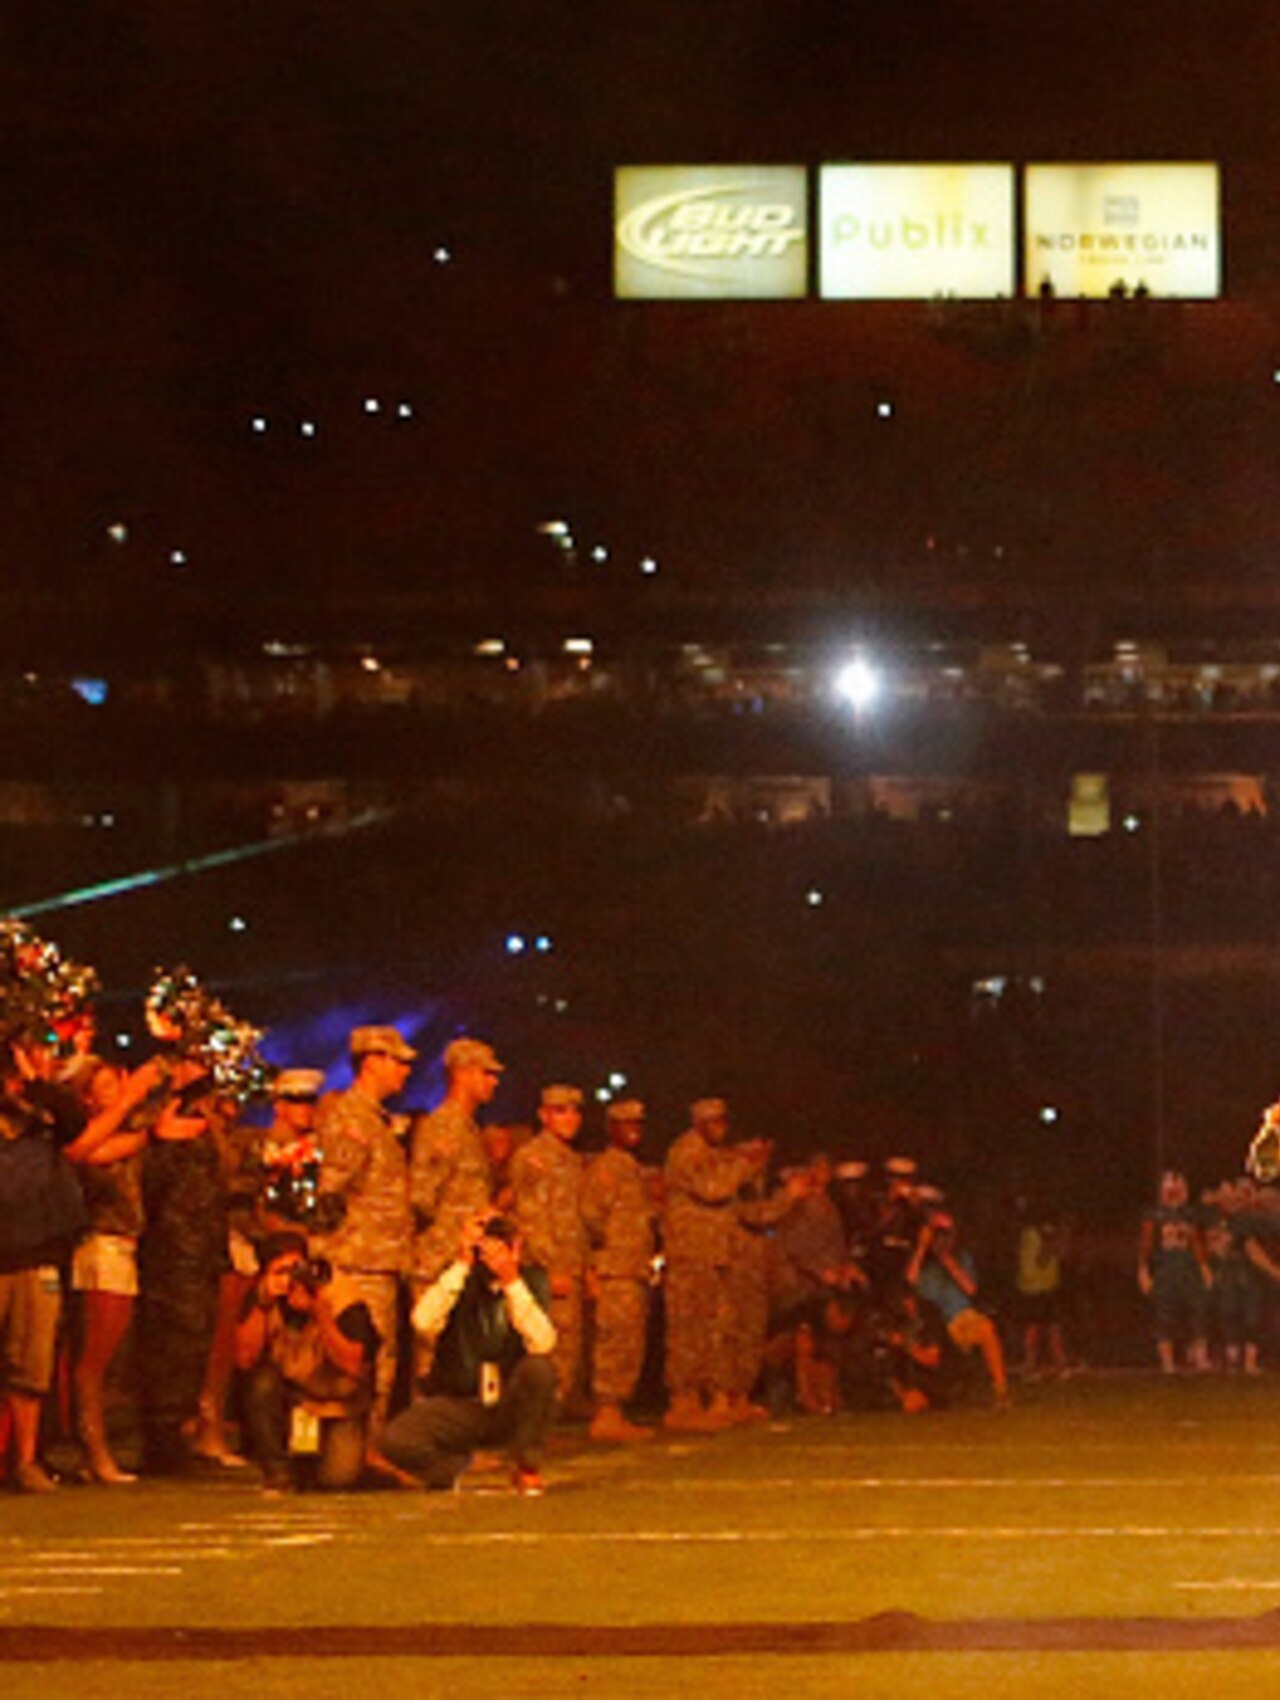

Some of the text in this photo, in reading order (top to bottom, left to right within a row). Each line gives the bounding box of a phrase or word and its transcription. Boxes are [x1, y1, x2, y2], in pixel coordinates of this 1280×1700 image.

[668, 202, 793, 229] BUD
[649, 228, 804, 256] LIGHT
[832, 212, 989, 249] Publix
[1036, 233, 1208, 250] NORWEGIAN
